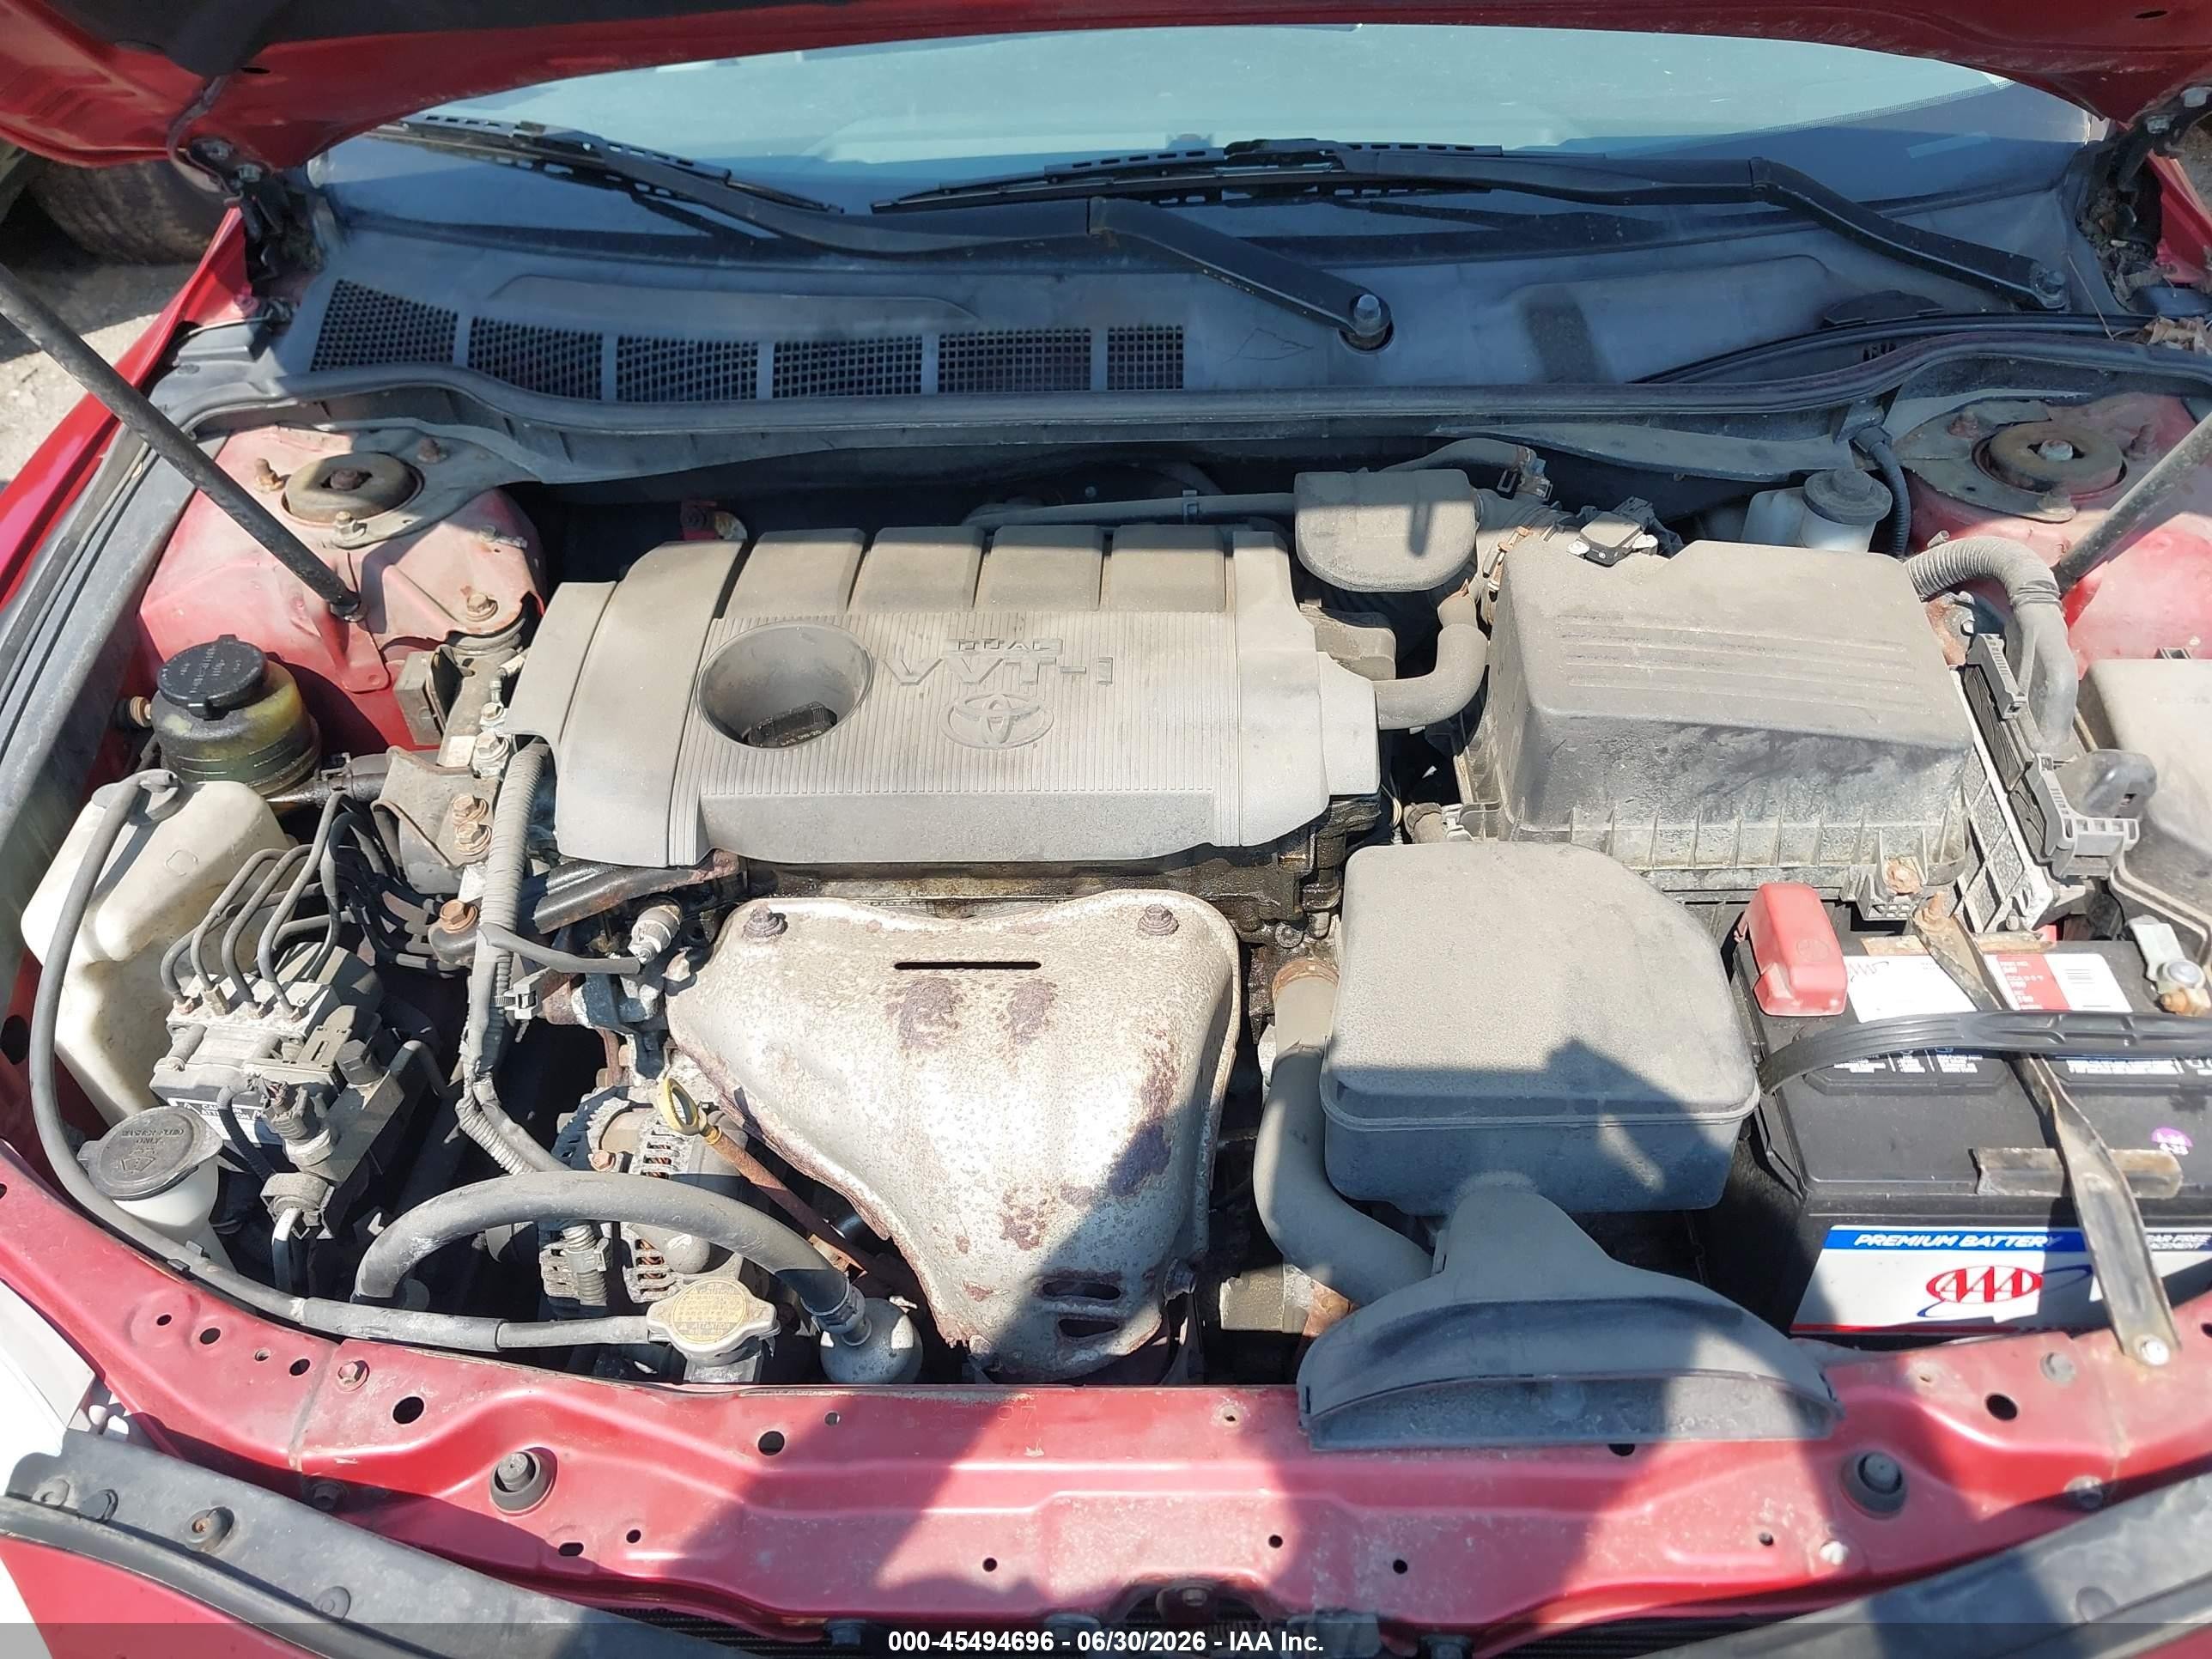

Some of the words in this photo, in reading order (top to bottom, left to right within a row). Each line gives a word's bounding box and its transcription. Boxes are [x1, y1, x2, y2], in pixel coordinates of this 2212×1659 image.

[1854, 1234, 1960, 1247] PREMIUM
[1959, 1235, 2063, 1248] BATTERY
[1930, 1265, 2033, 1304] AAA
